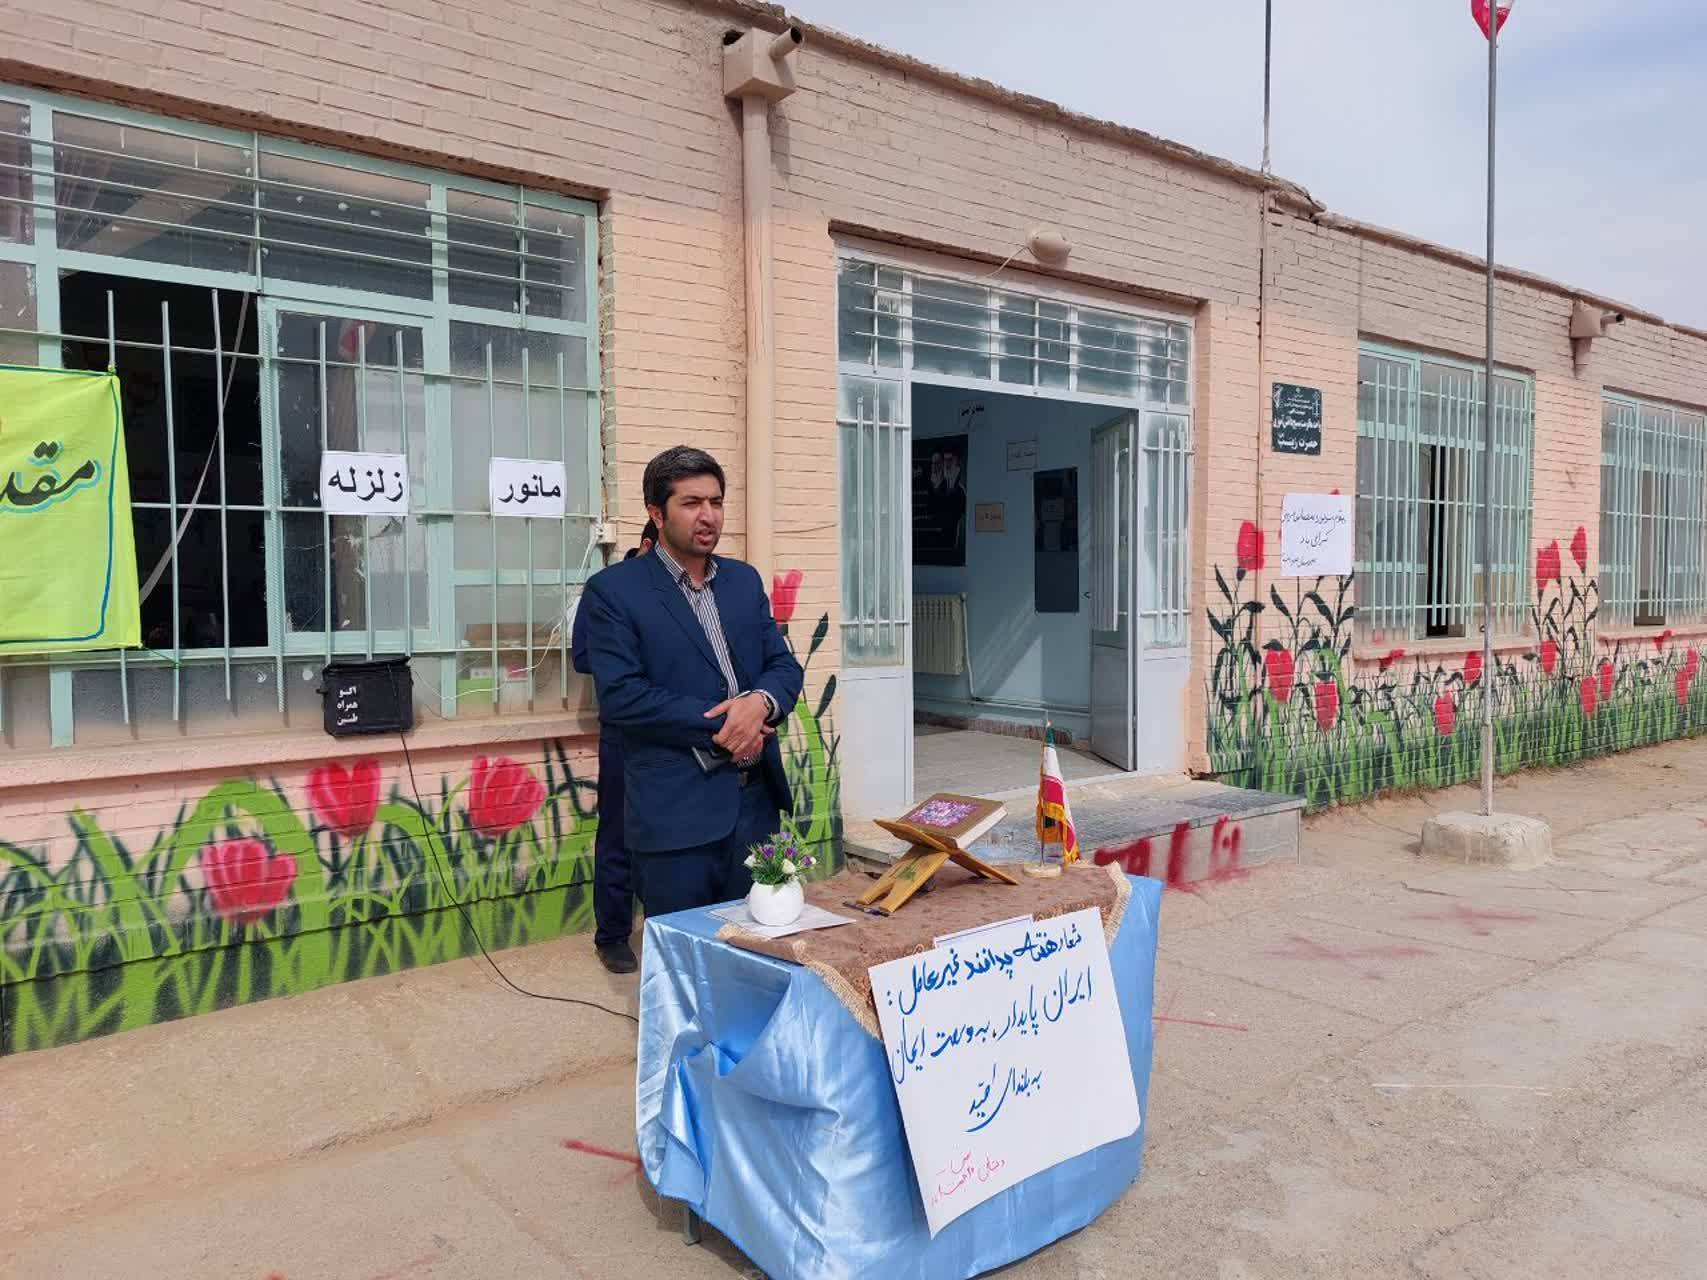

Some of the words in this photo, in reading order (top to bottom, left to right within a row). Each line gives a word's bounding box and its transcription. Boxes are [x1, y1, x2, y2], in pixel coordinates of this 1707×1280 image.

[328, 466, 404, 501] زلزله
[498, 475, 561, 503] مانور
[336, 699, 359, 711] همراه
[1013, 931, 1058, 962] هفته
[1057, 923, 1082, 950] شعار
[964, 948, 1014, 980] پدافند
[1043, 966, 1092, 1021] ایران
[891, 1018, 925, 1084] ایمان
[930, 1024, 974, 1057] وسعت
[1030, 1070, 1042, 1090] به
